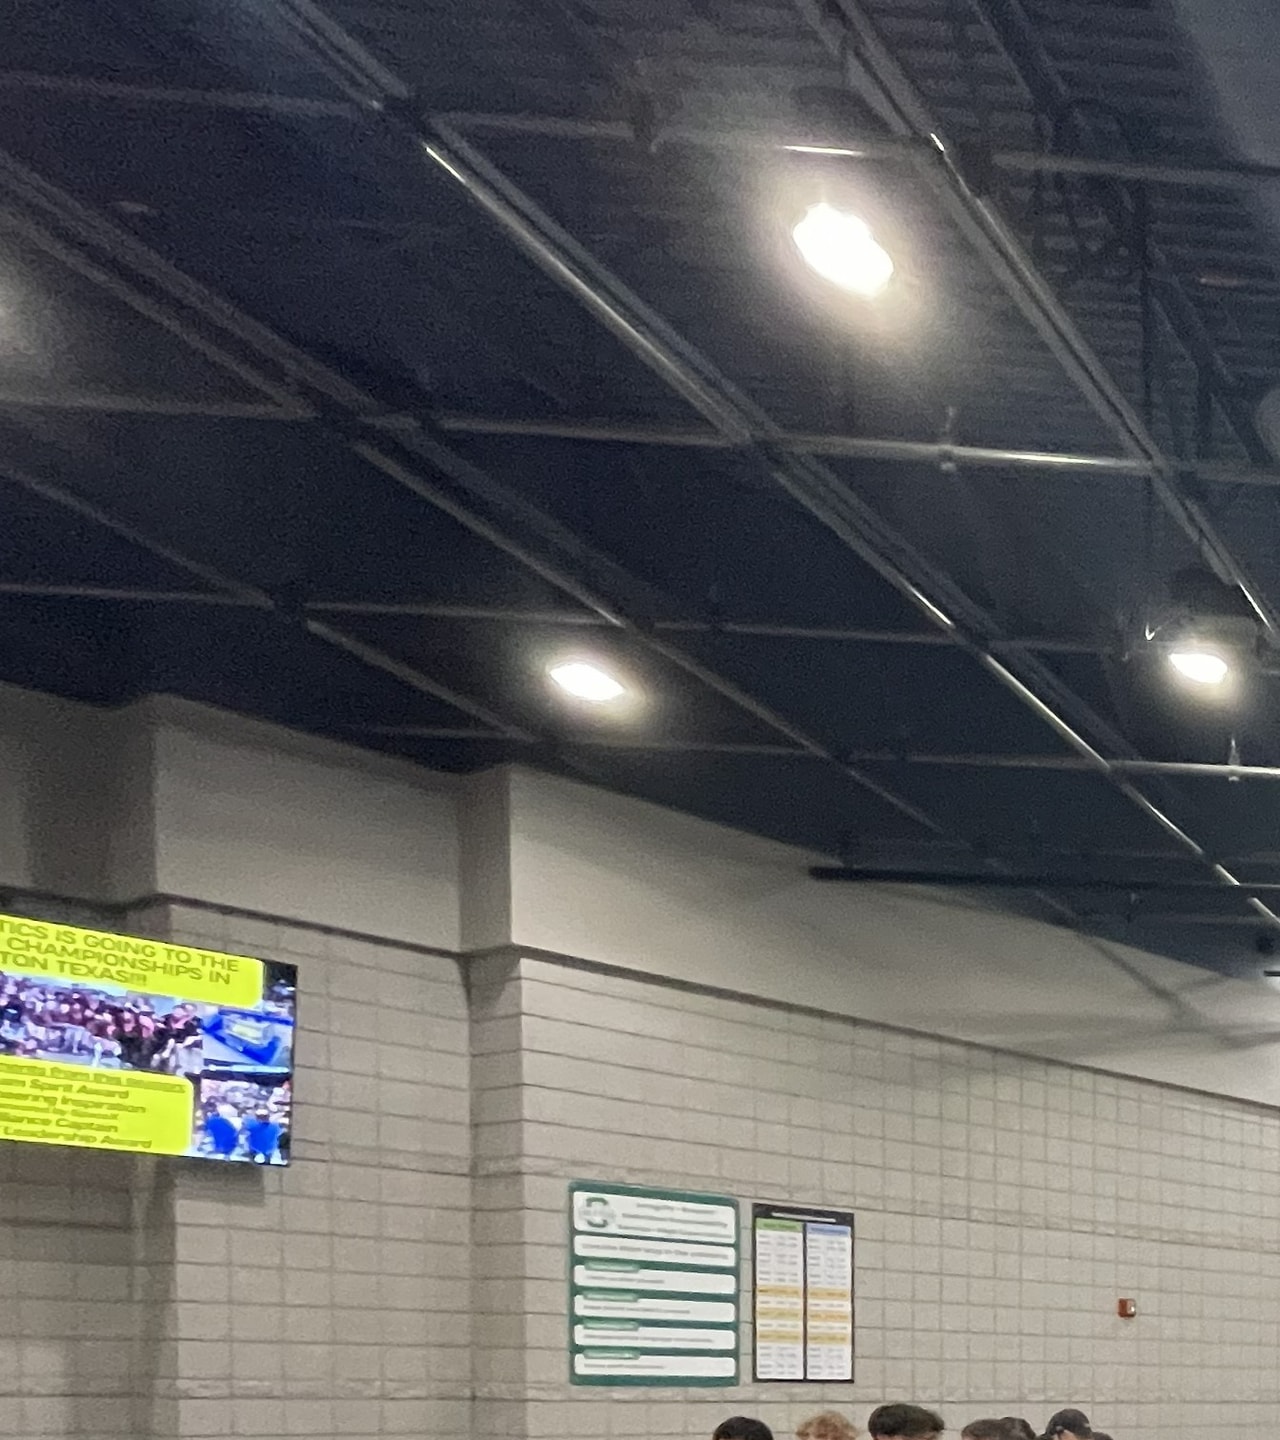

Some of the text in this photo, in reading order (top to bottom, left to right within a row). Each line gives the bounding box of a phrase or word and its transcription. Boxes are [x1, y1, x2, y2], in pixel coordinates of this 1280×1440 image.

[7, 937, 231, 985] CHAMPIONSHIPS IN
[55, 930, 76, 945] IS
[84, 935, 156, 957] GOING
[163, 947, 192, 963] TO
[199, 954, 240, 972] THE
